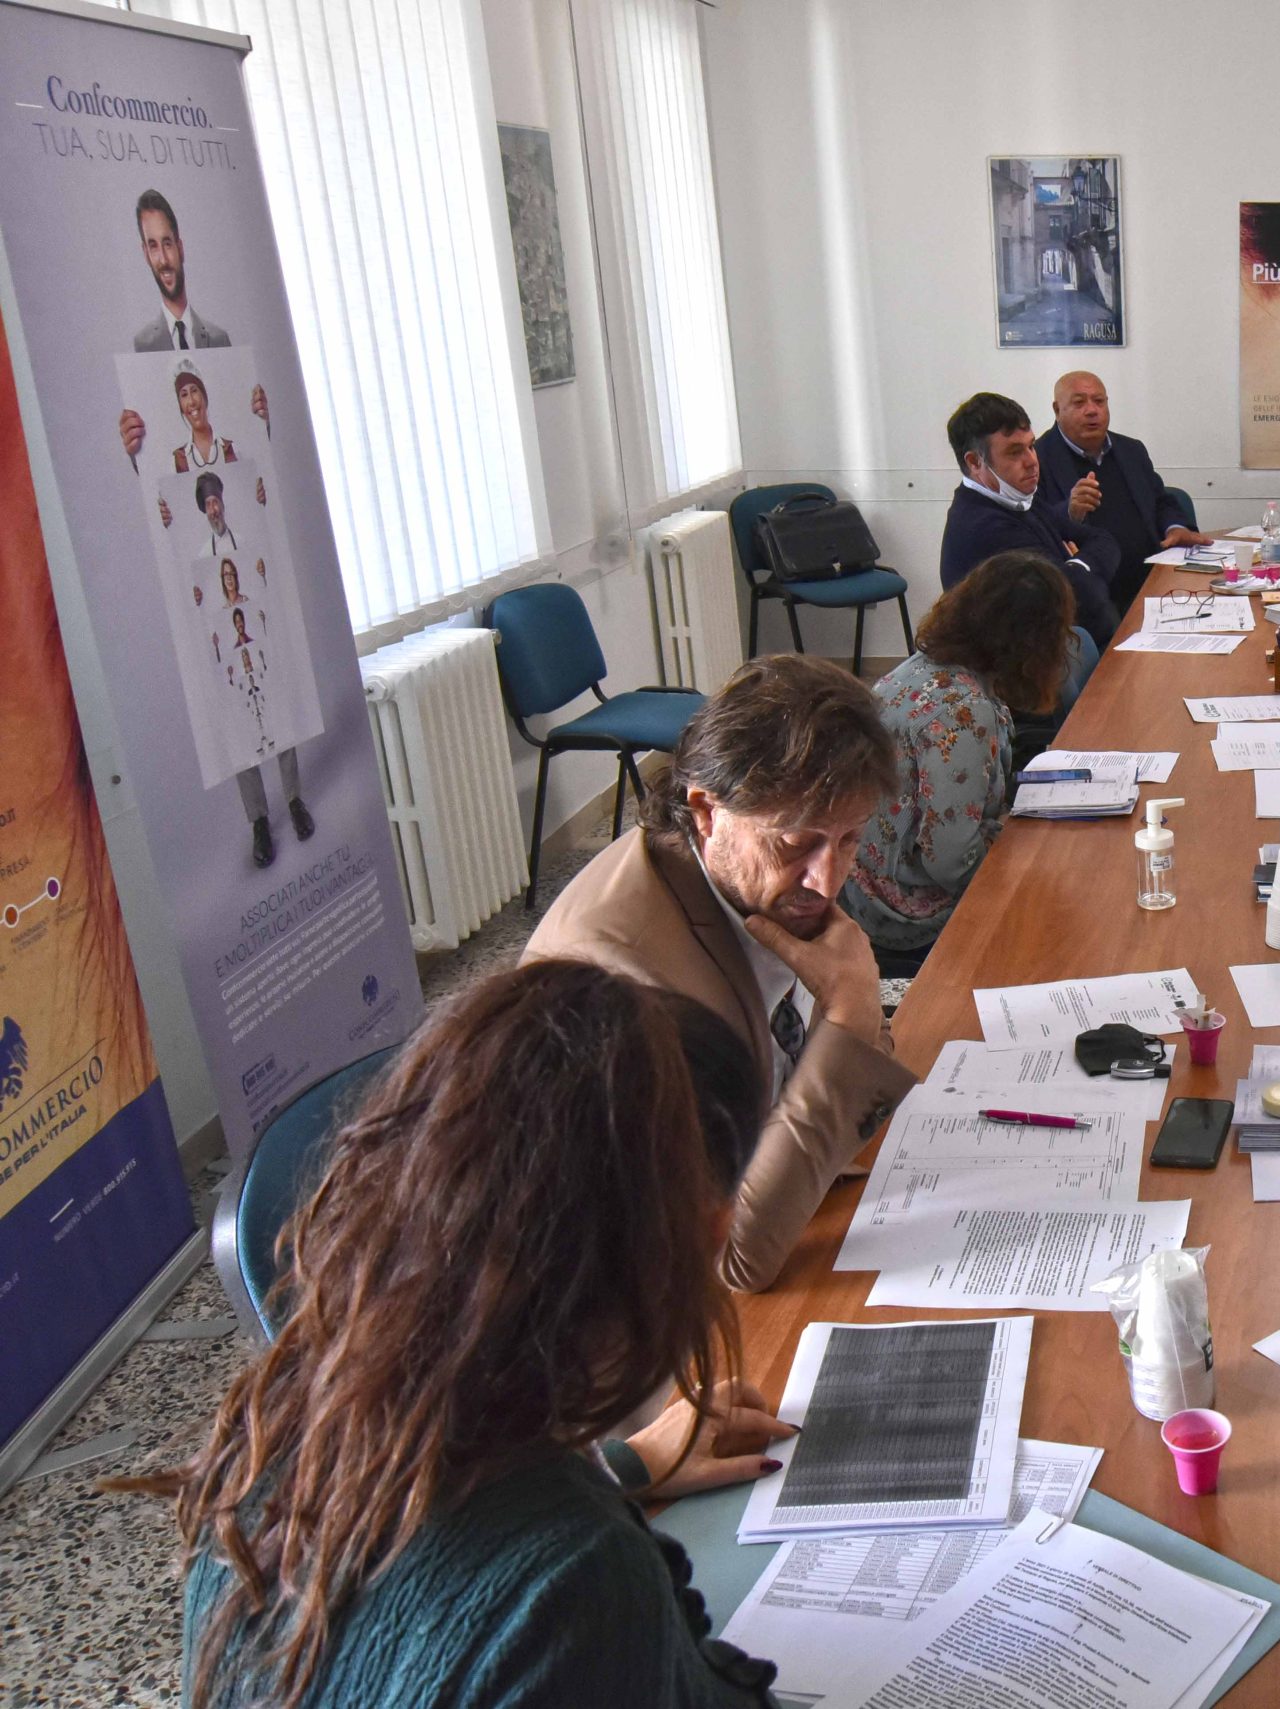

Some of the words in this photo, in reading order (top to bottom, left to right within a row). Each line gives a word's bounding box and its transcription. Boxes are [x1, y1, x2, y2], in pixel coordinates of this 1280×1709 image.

[47, 76, 213, 129] Confcommercio.
[32, 123, 93, 159] TUA.
[97, 128, 147, 163] SUA.
[151, 135, 174, 164] DI
[176, 137, 236, 170] TUTTI.
[1083, 321, 1117, 340] RAGUSA
[240, 881, 297, 931] ASSOCIATI
[299, 855, 334, 891] ANCHE
[335, 844, 350, 862] TU
[214, 958, 225, 978] E
[225, 910, 294, 966] MOLTIPLICA
[13, 1142, 40, 1172] PER
[40, 1104, 87, 1149] L'ITALIA
